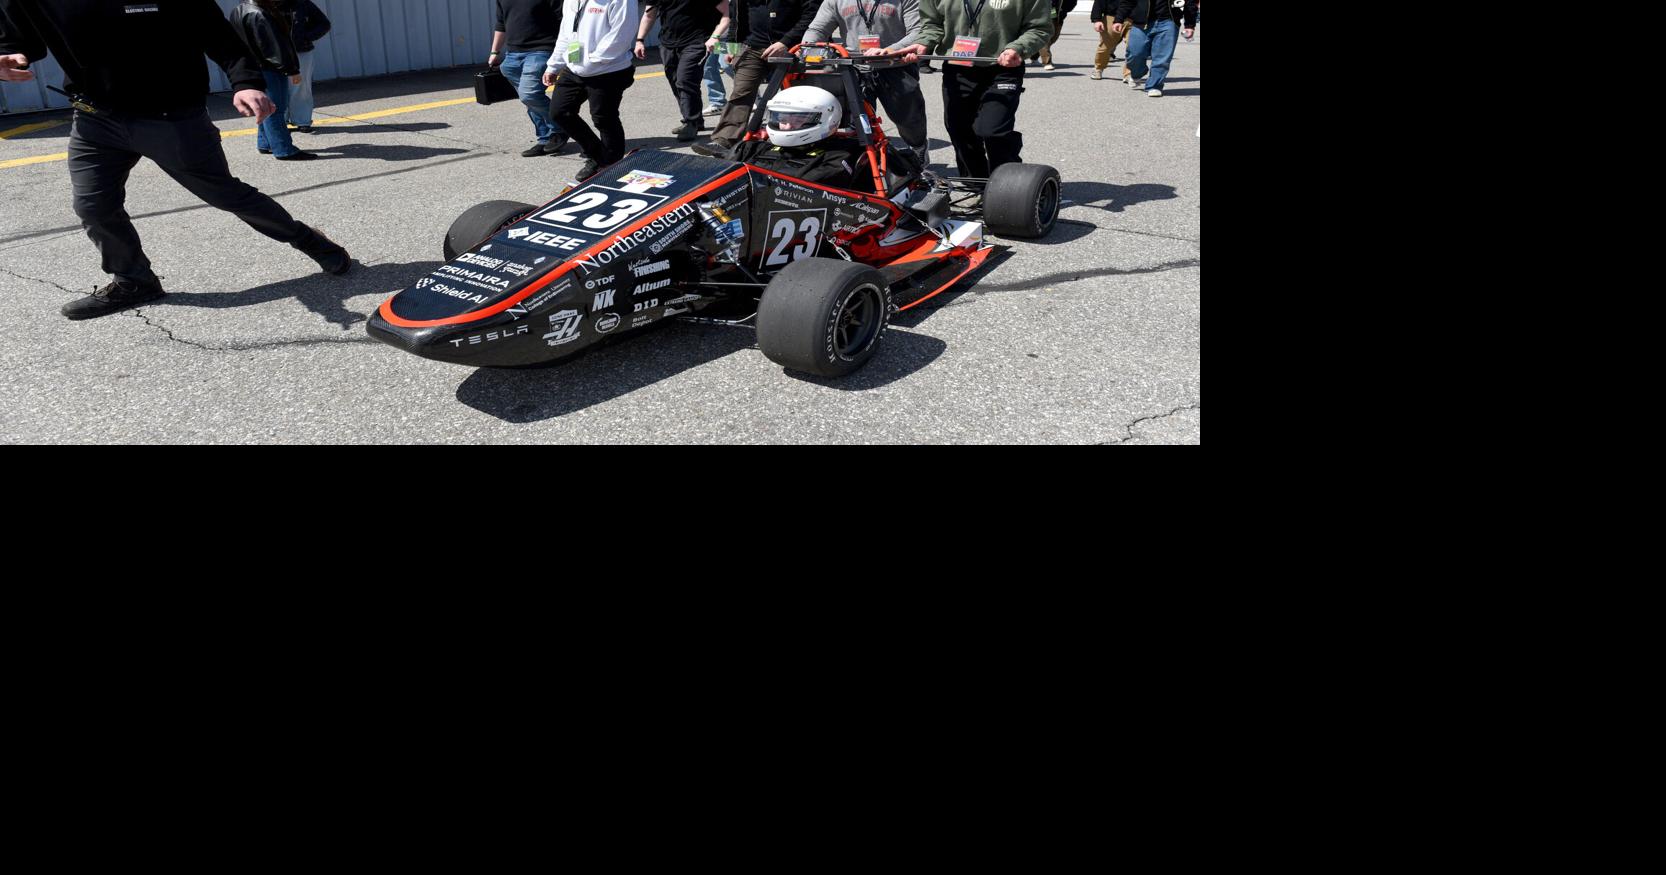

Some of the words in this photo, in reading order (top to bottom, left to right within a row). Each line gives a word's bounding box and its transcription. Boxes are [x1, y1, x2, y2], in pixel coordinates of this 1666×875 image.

[783, 190, 813, 204] RIVIAN
[821, 190, 847, 205] Ansys
[540, 191, 649, 230] 23
[523, 230, 587, 251] IEEE
[573, 202, 697, 276] Northeastern
[658, 230, 676, 244] SOUTH
[765, 216, 820, 266] 23
[473, 254, 504, 265] ANALOG
[634, 259, 671, 278] FINISHING
[437, 264, 511, 289] PRIMAIRA
[595, 274, 615, 286] TDF
[632, 278, 671, 296] Altium
[430, 283, 473, 300] Shield
[466, 293, 489, 304] AI
[592, 288, 616, 313] NK
[449, 324, 529, 348] TESLA
